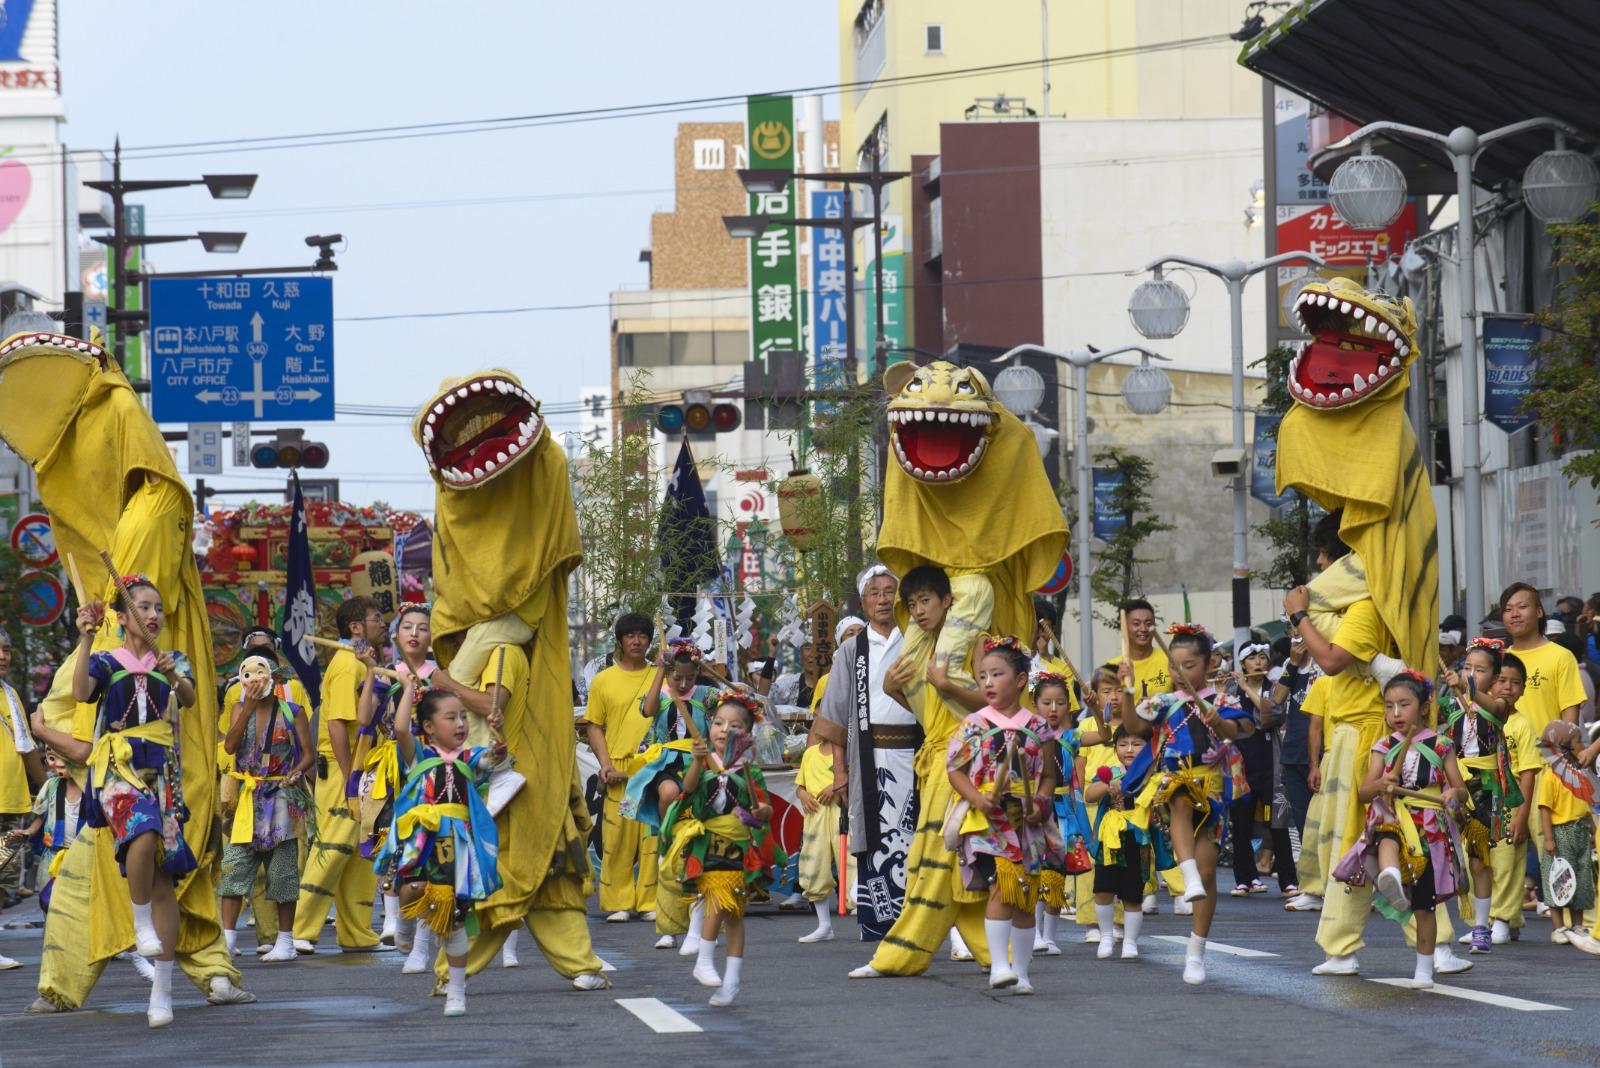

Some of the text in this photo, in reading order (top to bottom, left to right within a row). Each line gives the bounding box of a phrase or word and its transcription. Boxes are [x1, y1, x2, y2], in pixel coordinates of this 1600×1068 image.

[1278, 207, 1296, 218] 3F
[1309, 212, 1346, 230] カラ
[1279, 268, 1297, 279] 2F
[197, 281, 301, 299] 十和田 久慈
[207, 299, 291, 311] Towada Kuji
[183, 325, 240, 343] 本八戸駅
[284, 324, 326, 342] 大野
[249, 345, 265, 354] 340
[295, 342, 315, 353] Ono
[161, 357, 233, 375] 八戸市庁
[285, 356, 326, 373] 階上
[166, 375, 227, 386] CITY OFFICE
[281, 374, 330, 384] Hashikami
[224, 391, 238, 401] 23
